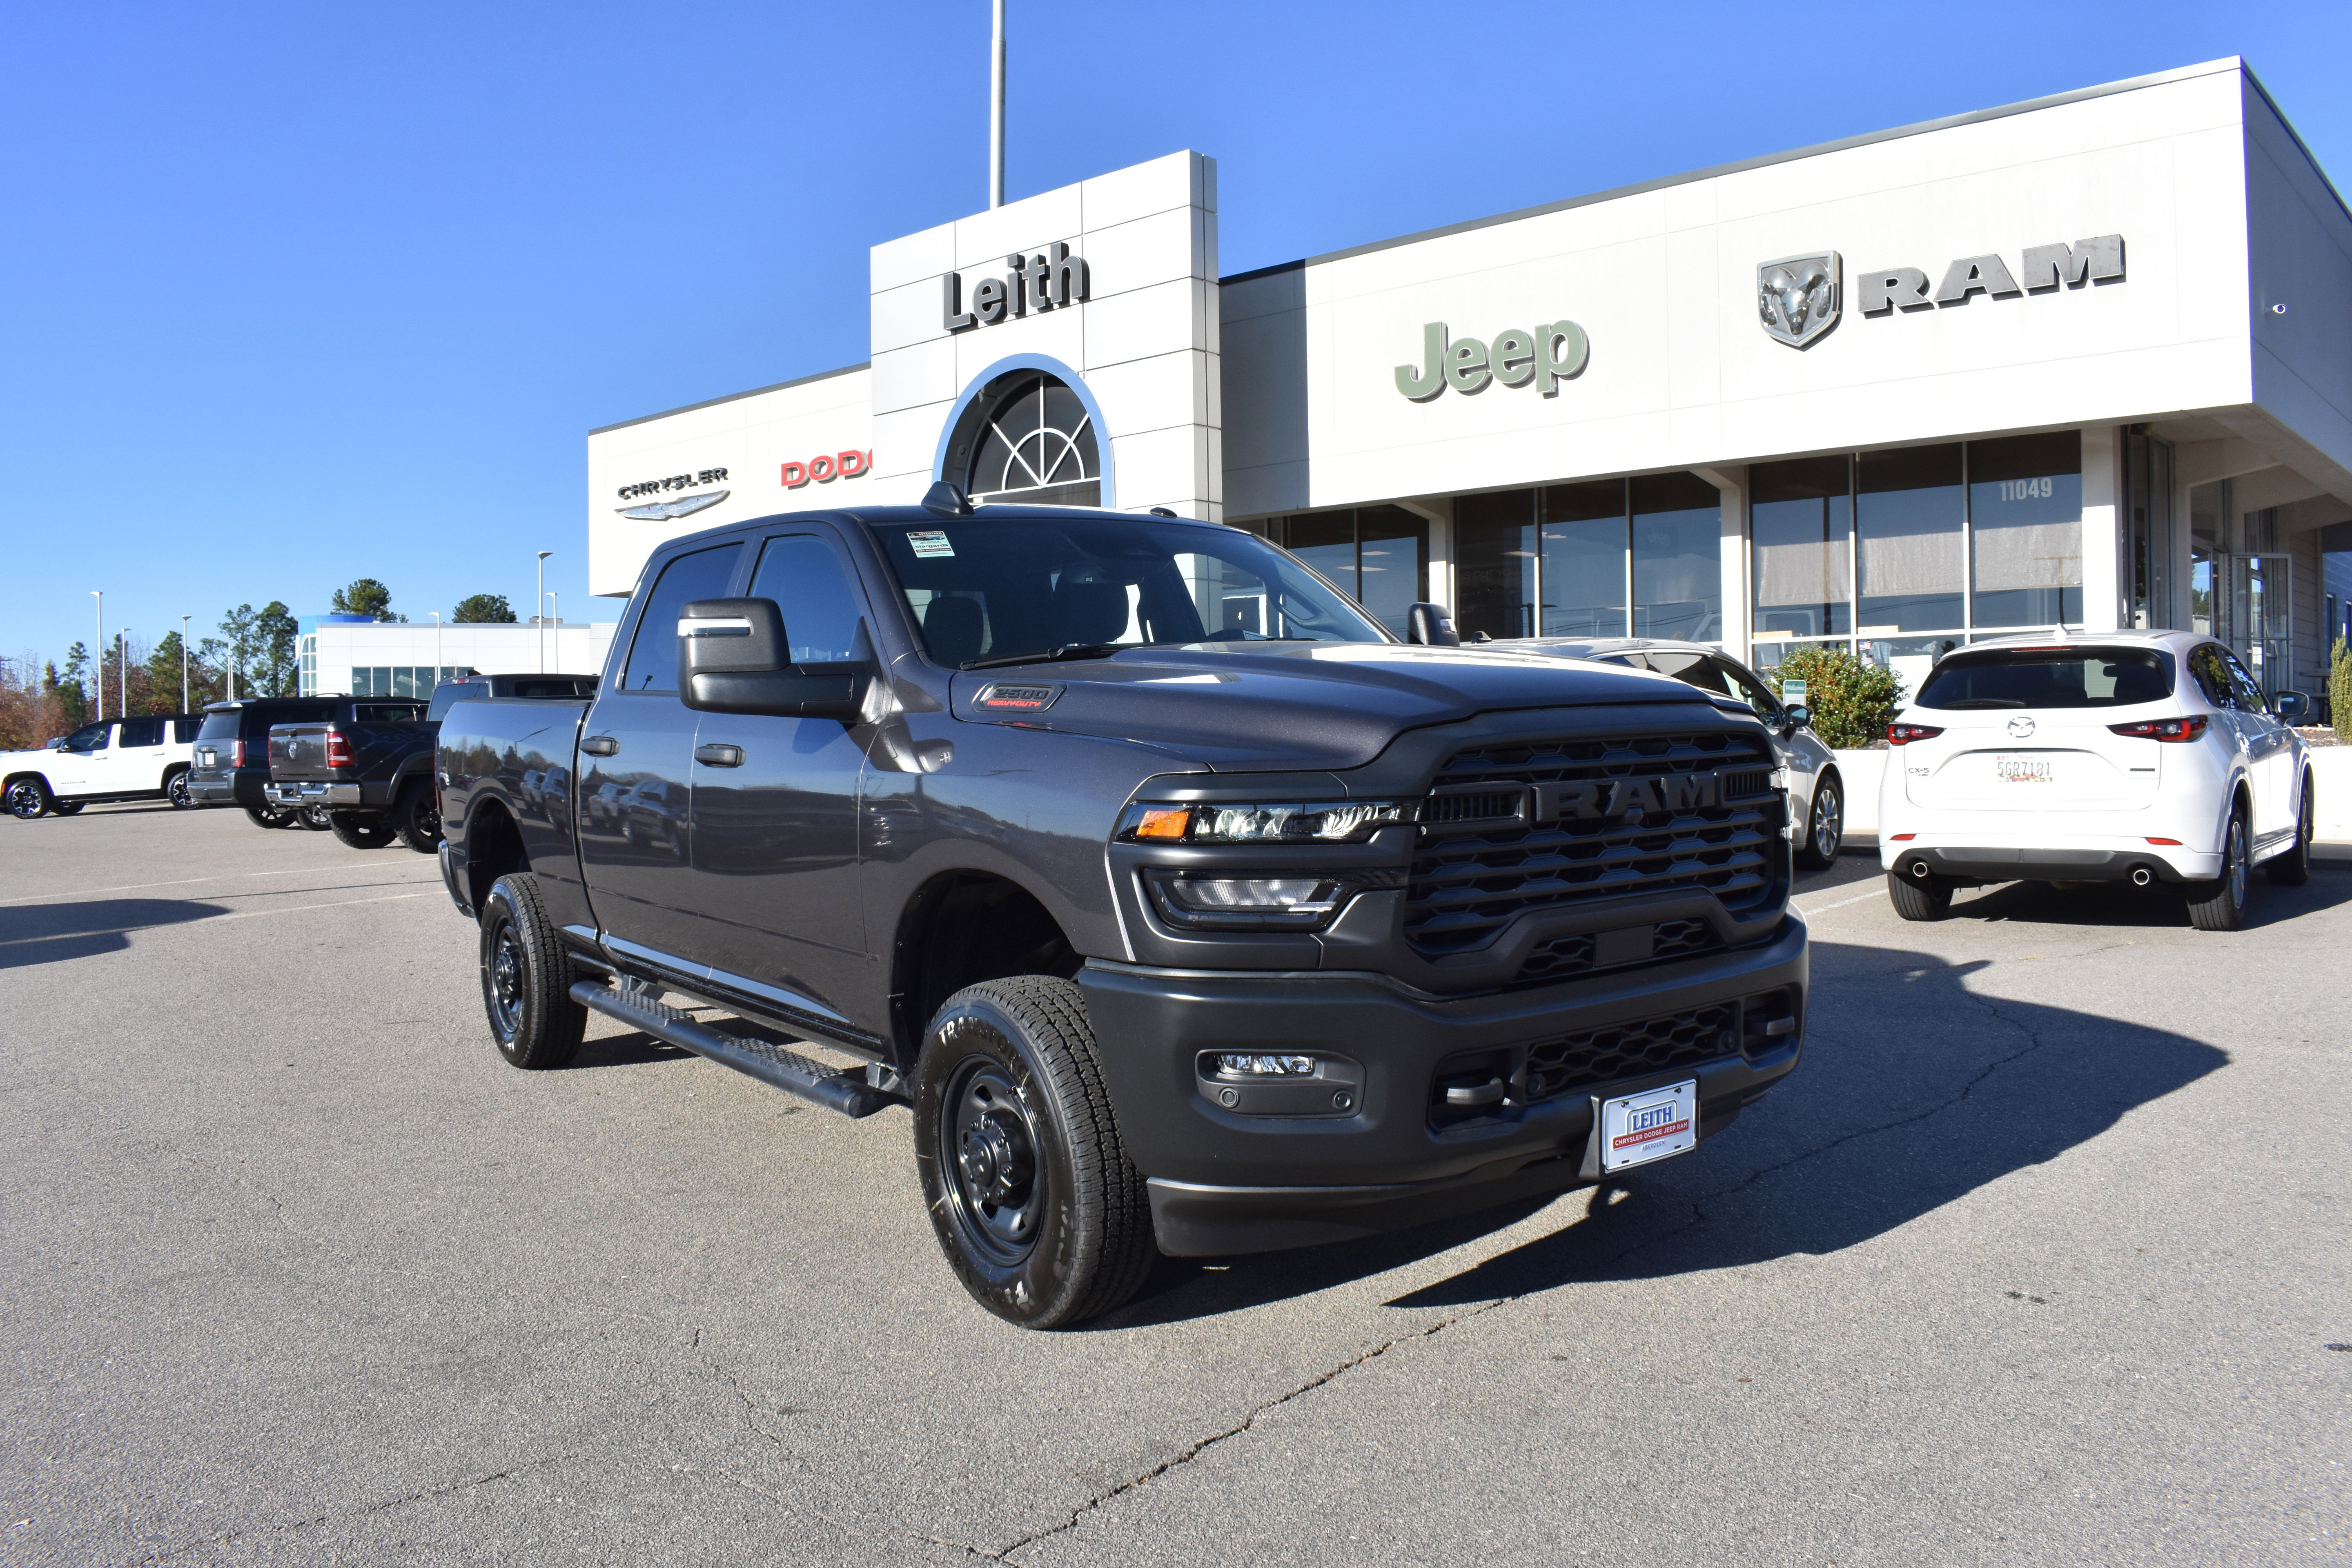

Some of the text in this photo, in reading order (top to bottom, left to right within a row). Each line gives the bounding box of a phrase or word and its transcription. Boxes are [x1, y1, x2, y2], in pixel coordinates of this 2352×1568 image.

[942, 241, 1090, 334] Leith
[1858, 234, 2126, 319] RAM
[1394, 319, 1590, 403] Jeep
[781, 448, 873, 489] DOD
[618, 467, 728, 500] CHRYSLER
[2000, 477, 2052, 501] 11049
[993, 689, 1049, 699] 2500
[1998, 762, 2049, 776] 5GR7181
[1536, 775, 1715, 822] RAM
[1633, 1106, 1672, 1131] LEITH
[1615, 1134, 1643, 1146] CHRYSLER
[1644, 1129, 1662, 1138] DODGE
[1643, 1141, 1665, 1150] ABERDEEN
